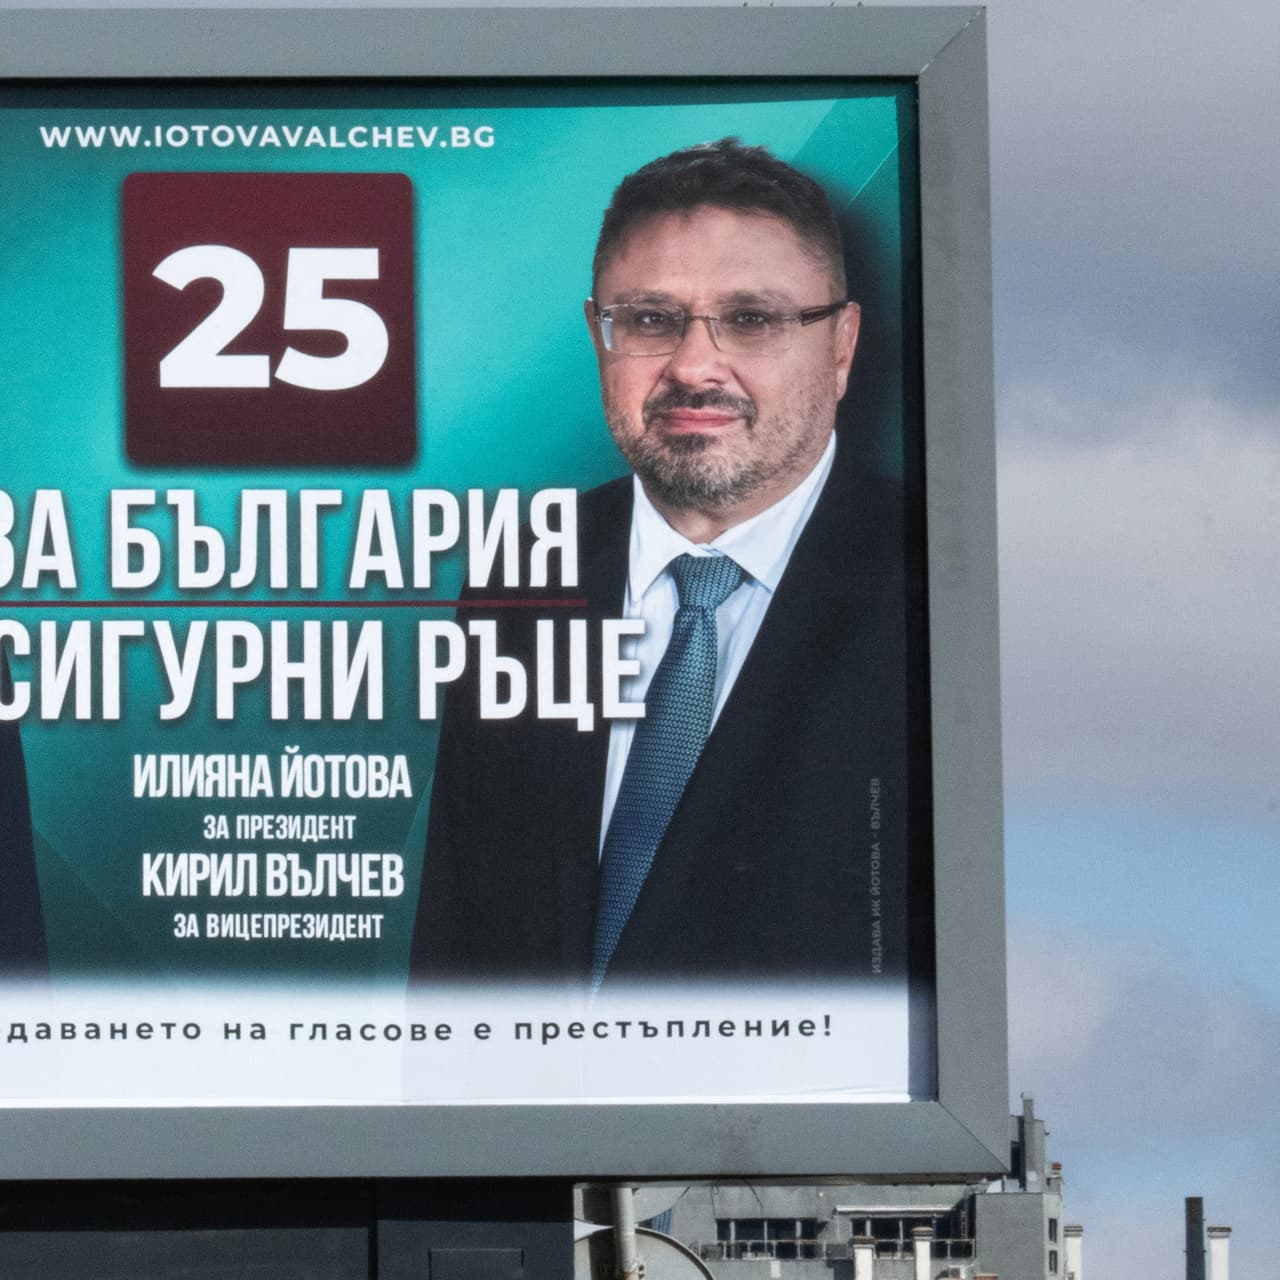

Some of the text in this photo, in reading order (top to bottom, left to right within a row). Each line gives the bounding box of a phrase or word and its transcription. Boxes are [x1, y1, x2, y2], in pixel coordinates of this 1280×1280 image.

[39, 125, 495, 148] WWW.IOTOVAVALCHEV.BG
[153, 245, 389, 391] 25
[111, 489, 578, 589] БЪЛГАРИЯ
[419, 619, 647, 732] РЪЦЕ
[134, 746, 413, 798] ИЛИЯНА ЙОТОВА
[203, 814, 357, 842] ЗА ПРЕЗИДЕНТ
[870, 778, 881, 830] ВЪЛЧЕВ
[142, 853, 405, 897] КИРИЛ ВЪЛЧЕВ
[869, 842, 881, 895] ЙОТОВА
[173, 913, 384, 941] ЗА ВИЦЕПРЕЗИДЕНТ
[871, 899, 881, 917] ИК
[871, 920, 882, 974] ИЗДАВА
[224, 1022, 267, 1040] на
[290, 1022, 452, 1042] гласове
[474, 1022, 491, 1040] е
[515, 1014, 831, 1045] престъпление!
